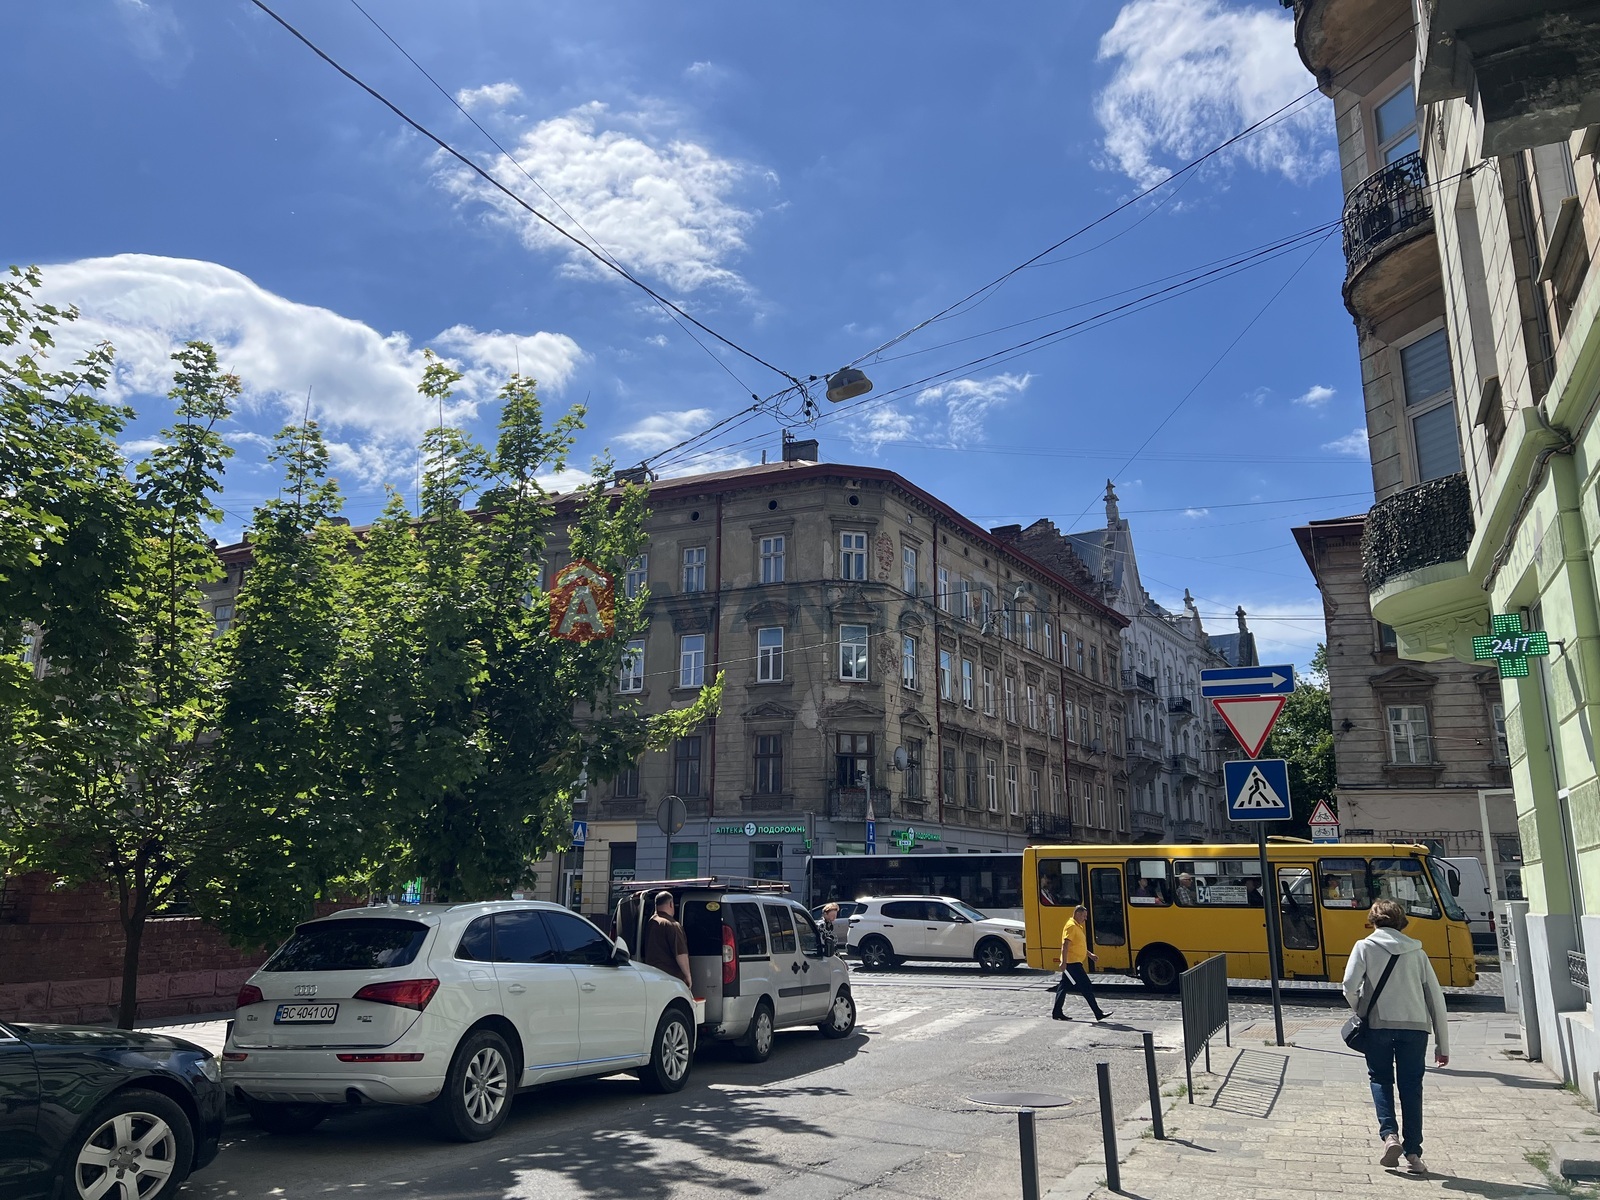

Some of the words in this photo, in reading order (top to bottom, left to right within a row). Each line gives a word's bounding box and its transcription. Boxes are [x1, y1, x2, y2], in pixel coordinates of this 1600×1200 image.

[1491, 637, 1529, 654] 24/7
[758, 826, 806, 834] ПОДОРОЖНИ
[1198, 887, 1211, 903] 34
[281, 1007, 296, 1019] BC
[296, 1007, 320, 1019] 4041
